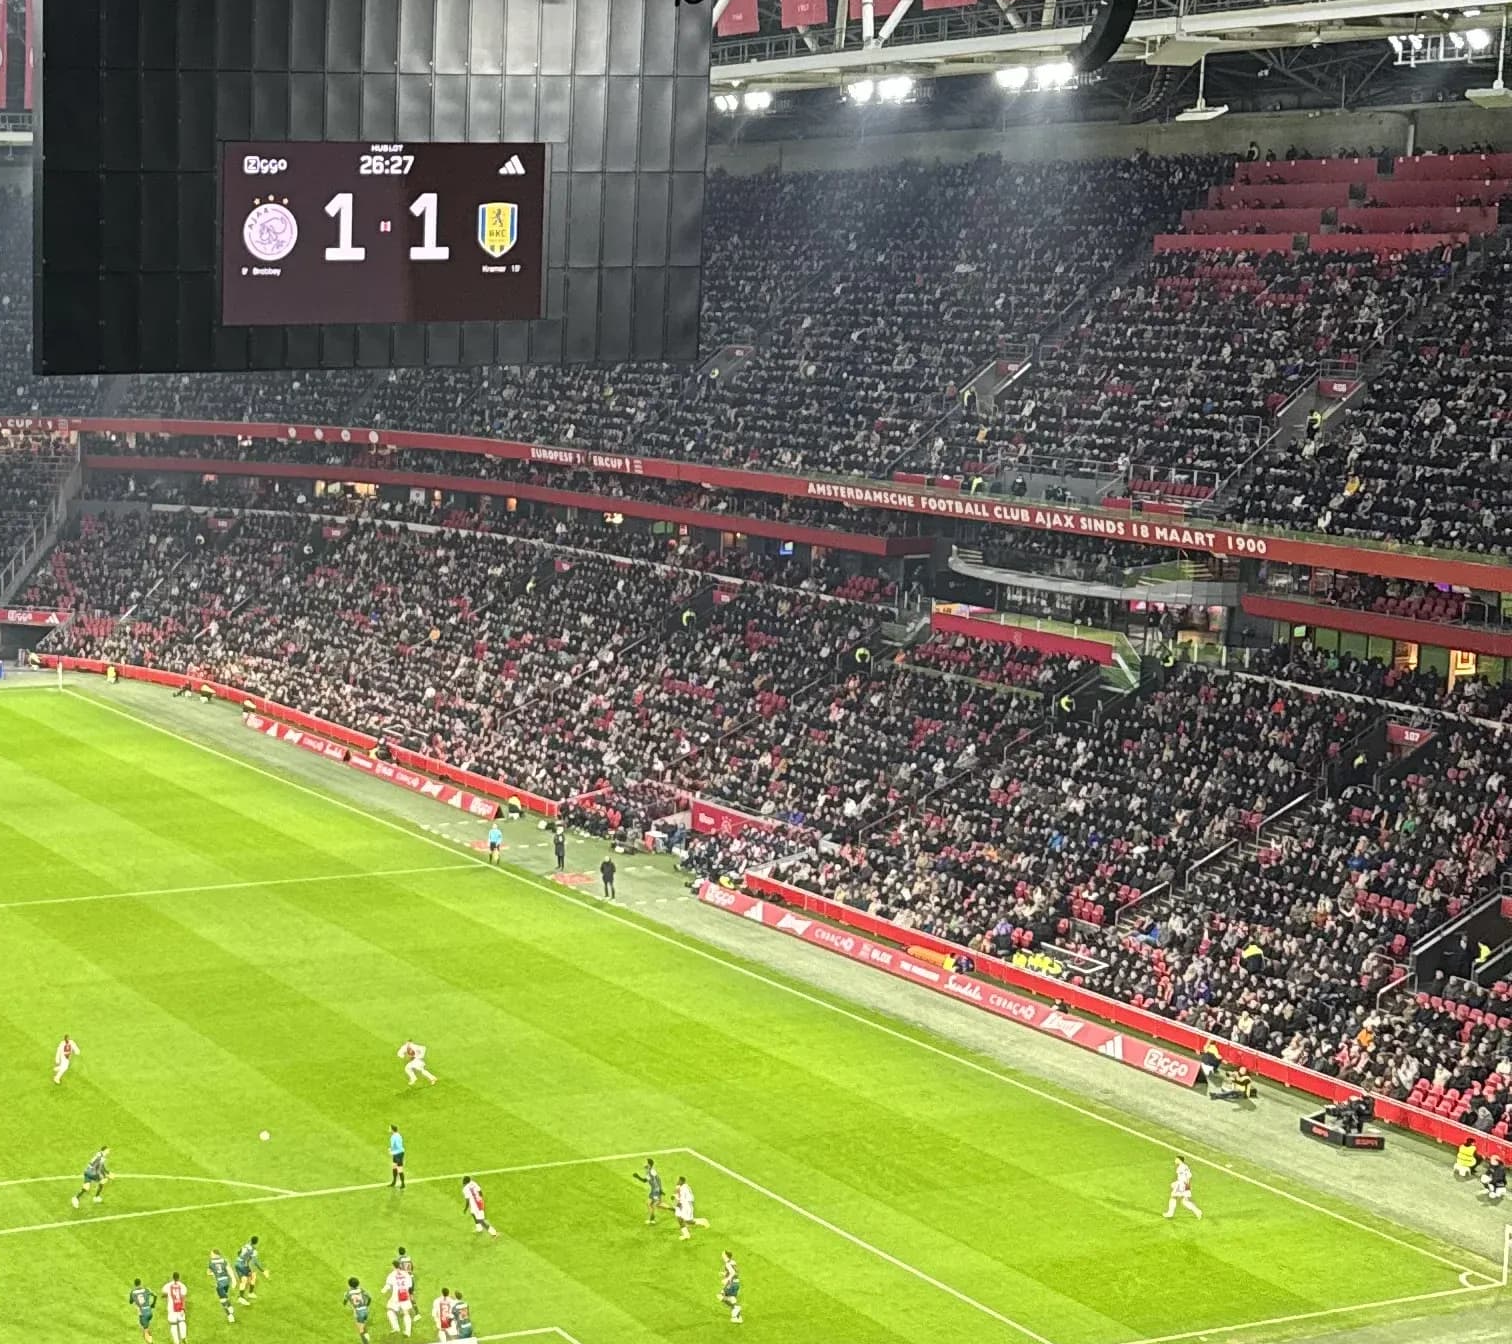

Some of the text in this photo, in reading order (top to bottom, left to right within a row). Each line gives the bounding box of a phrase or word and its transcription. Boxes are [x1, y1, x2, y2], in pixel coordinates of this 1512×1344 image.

[360, 155, 415, 174] 26:27
[324, 193, 449, 260] 1 1
[7, 418, 33, 429] CUP
[807, 482, 1267, 554] AMSTERDAMSCHE FOOTBALL CLUB AJAX SINDS 18 MAART 1900
